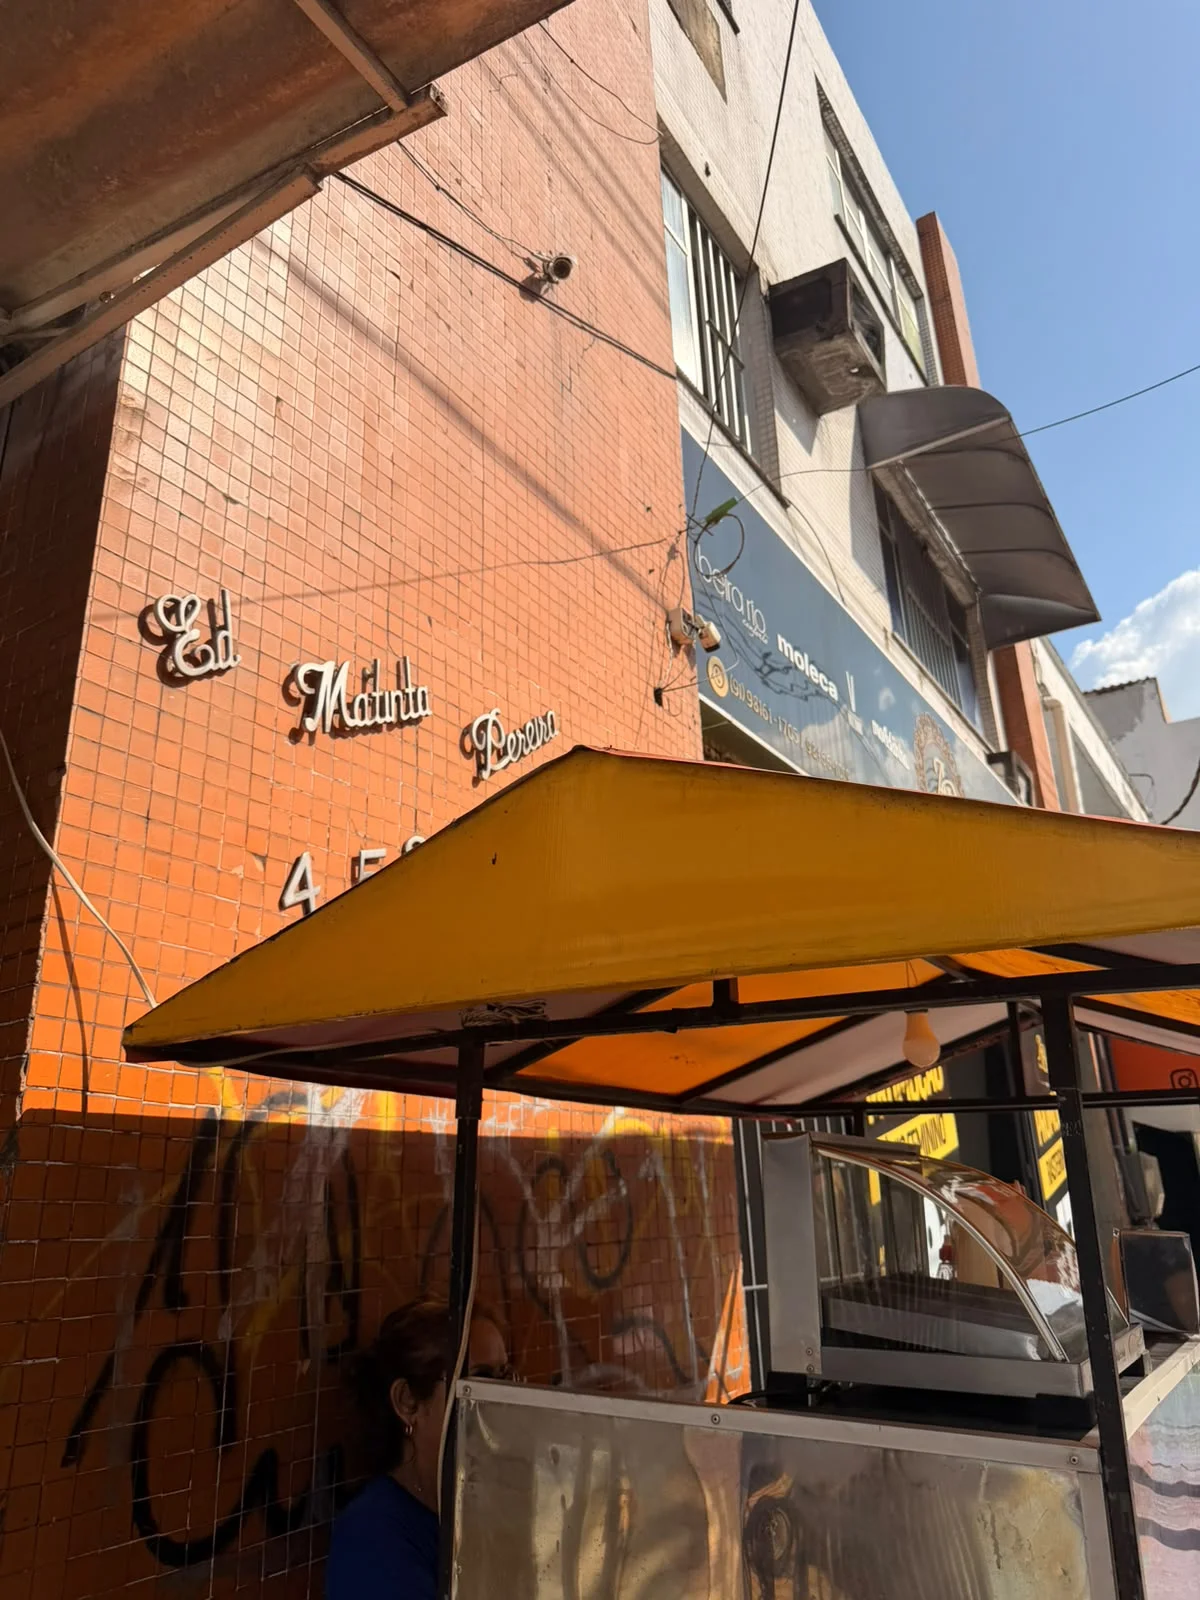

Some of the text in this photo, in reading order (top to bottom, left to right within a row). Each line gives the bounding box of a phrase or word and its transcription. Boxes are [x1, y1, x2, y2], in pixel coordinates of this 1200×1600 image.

[157, 588, 560, 780] Ed Matinta Pereira
[777, 633, 839, 702] moleca
